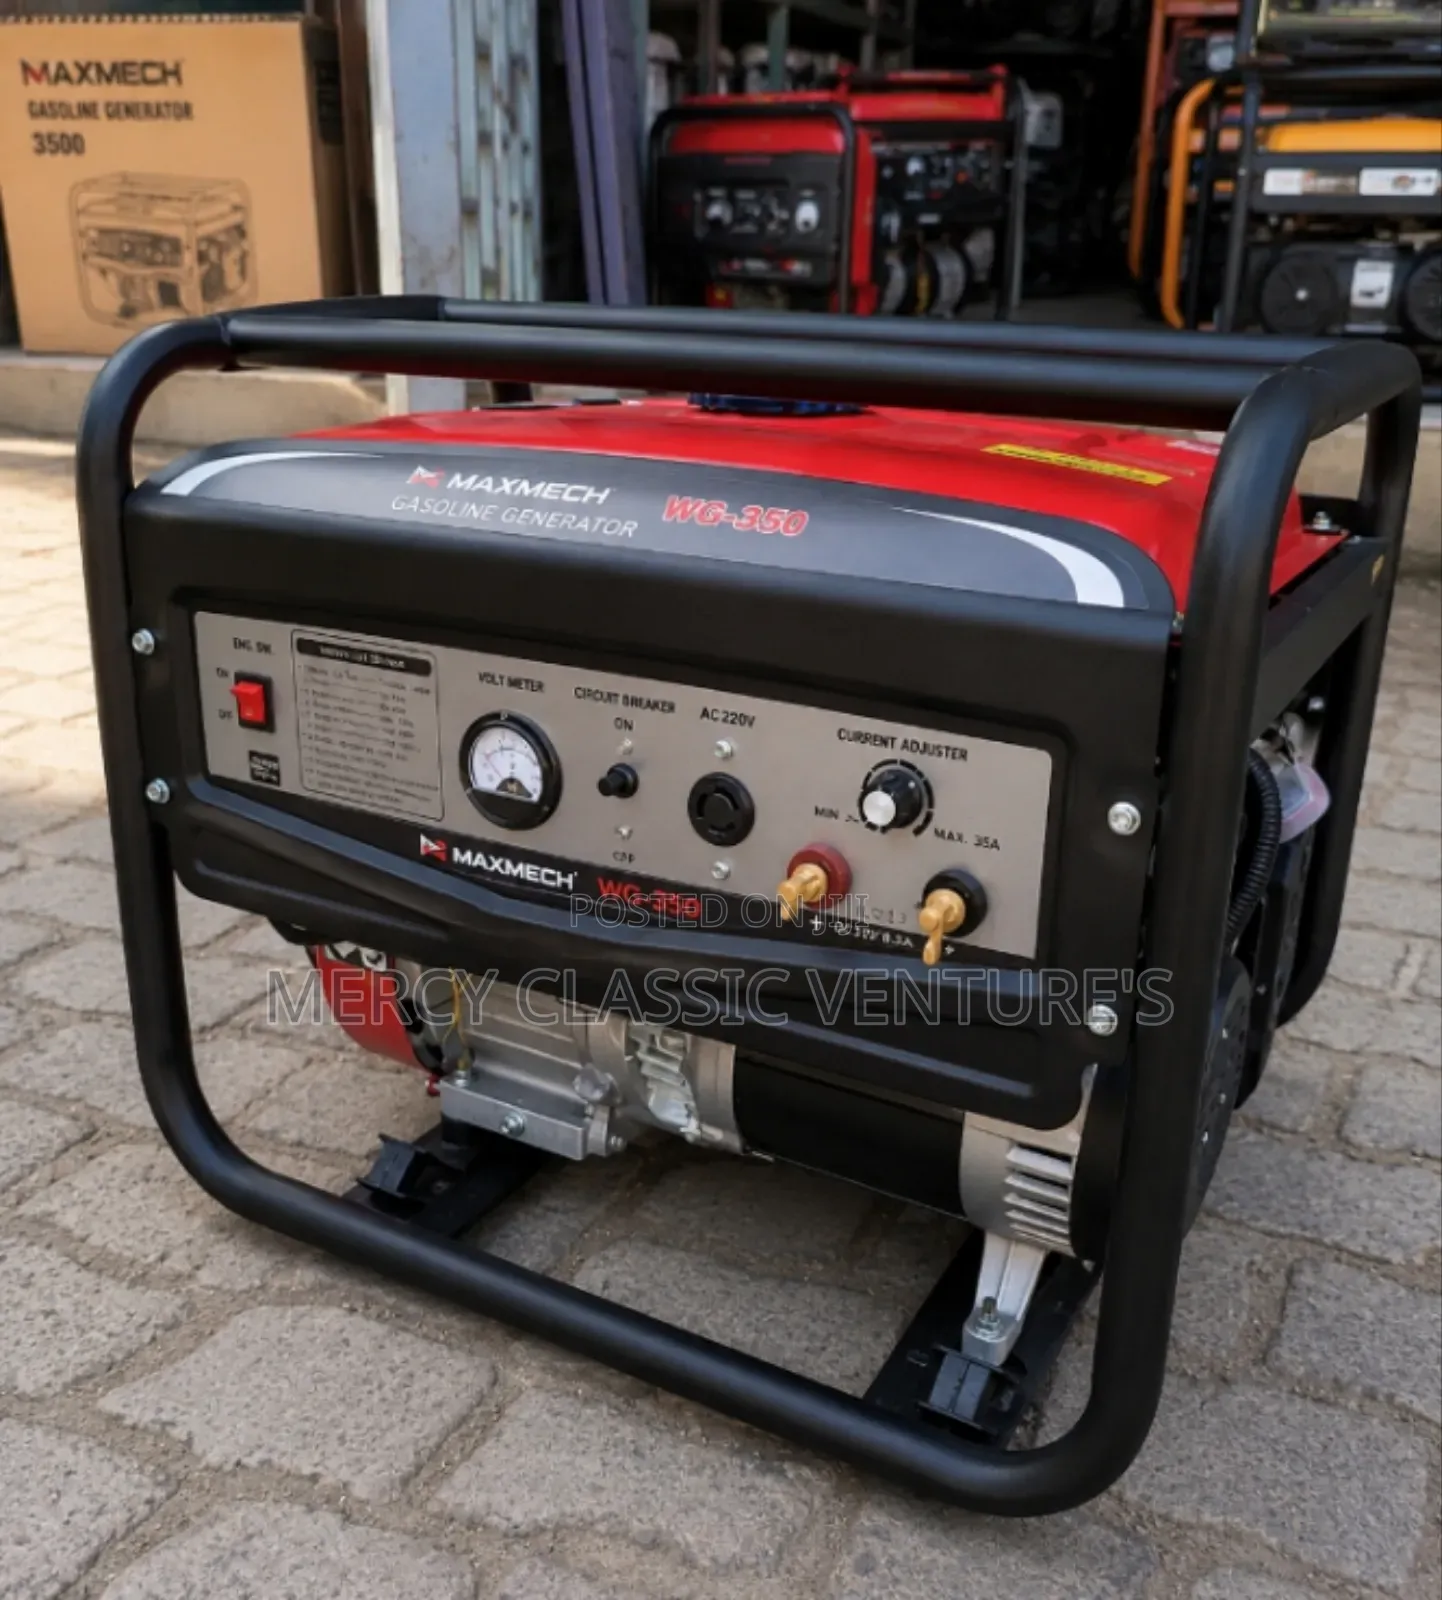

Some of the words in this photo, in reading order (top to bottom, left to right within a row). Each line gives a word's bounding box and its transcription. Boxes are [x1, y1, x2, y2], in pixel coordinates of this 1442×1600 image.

[20, 59, 182, 86] MAXMECH
[28, 101, 99, 120] GASOLINE
[105, 101, 194, 122] GENERATOR
[33, 132, 86, 156] 3500
[391, 496, 496, 523] GASOLINE
[500, 507, 639, 538] GENERATOR
[447, 473, 611, 505] MAXMECH
[662, 495, 808, 536] WG-350
[477, 672, 504, 687] VOLT
[506, 677, 545, 693] METER
[574, 686, 620, 703] CIRCUIT
[622, 694, 676, 714] BREAKER
[613, 716, 634, 732] ON
[837, 727, 897, 750] CURRENT
[901, 738, 968, 763] ADJUSTER
[451, 847, 574, 891] MAXMECH
